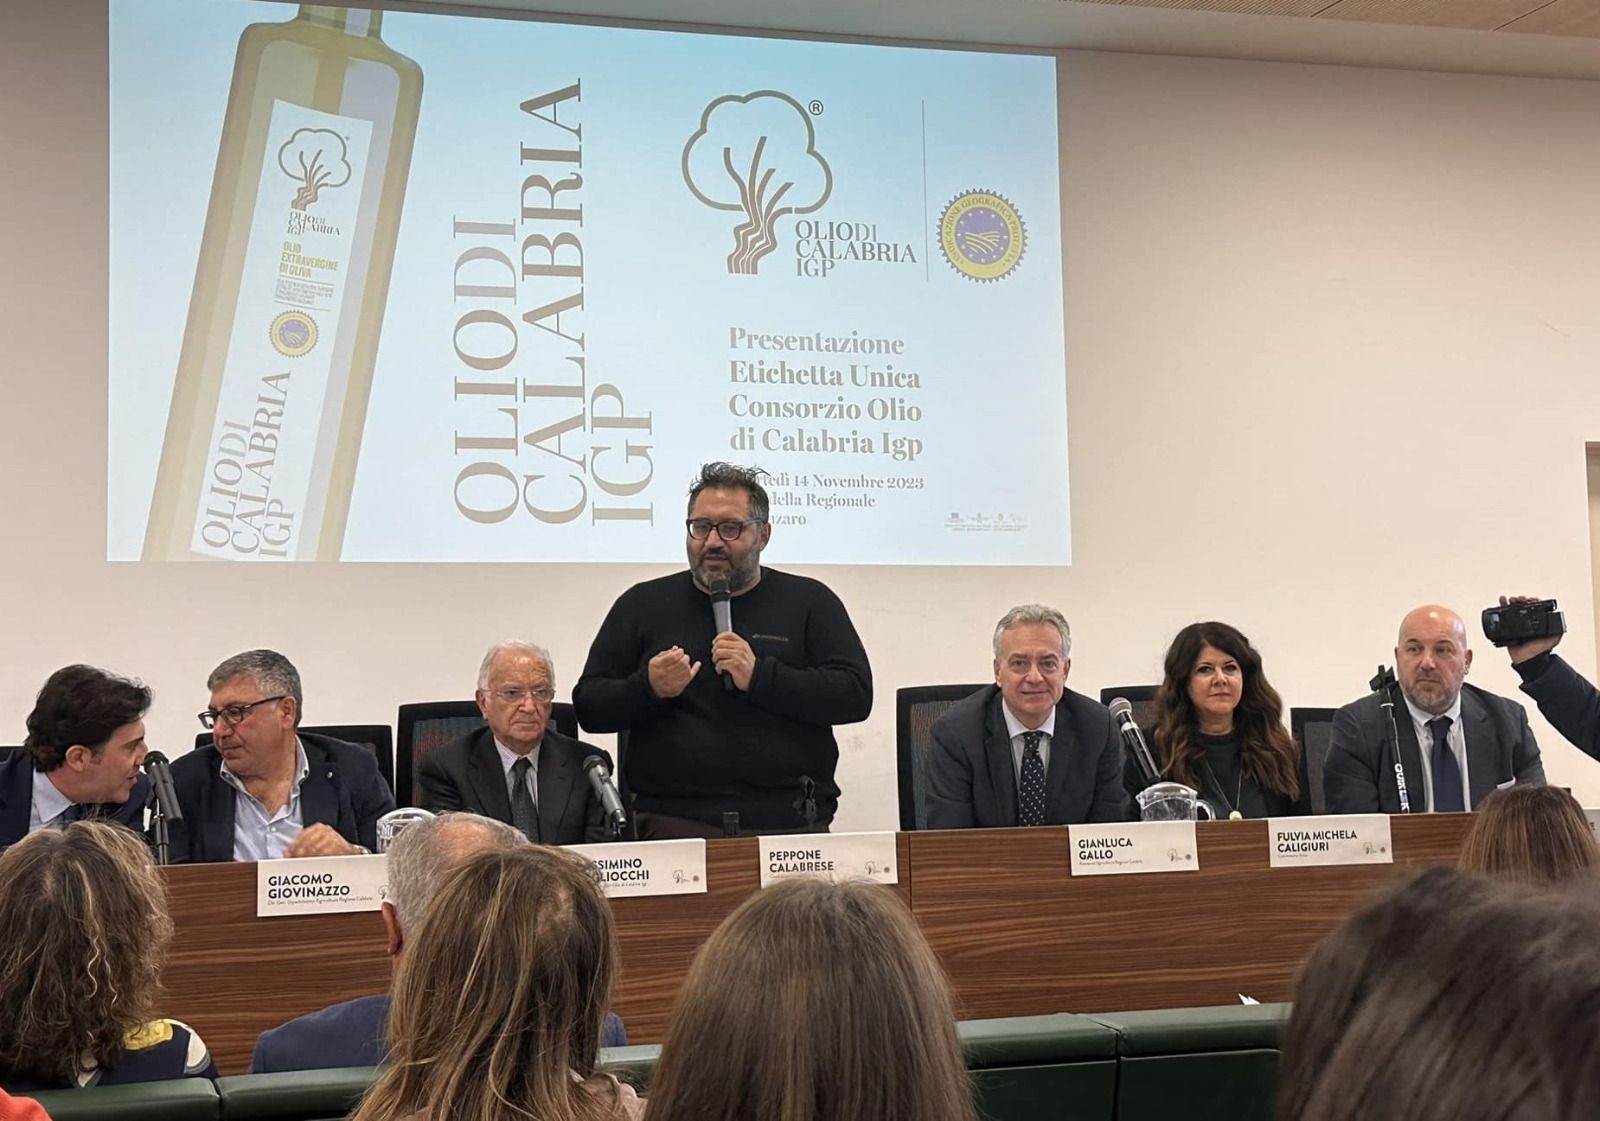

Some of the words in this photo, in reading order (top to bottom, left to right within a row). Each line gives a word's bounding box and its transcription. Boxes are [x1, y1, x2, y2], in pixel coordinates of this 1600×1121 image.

[283, 241, 302, 253] OLIO
[796, 239, 917, 263] CALABRIA
[279, 262, 288, 273] DI
[289, 265, 312, 278] OLIVA
[281, 252, 339, 271] EXTRAVERGINE
[796, 258, 835, 277] IGP
[520, 77, 587, 524] CALABRIA
[729, 327, 904, 355] Presentazione
[730, 360, 844, 386] Etichetta
[850, 364, 921, 388] Unica
[729, 394, 861, 420] Consorzio
[867, 397, 922, 421] Olio
[730, 426, 755, 451] di
[762, 428, 874, 454] Calabria
[882, 432, 923, 462] Igp
[231, 370, 291, 553] CALABRIA
[590, 383, 654, 527] IGP
[756, 472, 789, 487] rtedì
[795, 475, 809, 487] 14
[813, 473, 884, 489] Novembre
[887, 477, 924, 489] 2023
[806, 493, 876, 510] Regionale
[258, 498, 295, 557] IGP
[1078, 837, 1133, 849] GIANLUCA
[1277, 831, 1311, 842] FULVIA
[1313, 830, 1358, 840] MICHELA
[769, 850, 821, 861] PEPPONE
[1079, 849, 1113, 860] GALLO
[1277, 842, 1329, 853] CALIGIURI
[769, 861, 834, 873] CALABRESE
[268, 873, 333, 887] GIACOMO
[268, 885, 350, 899] GIOVINAZZO
